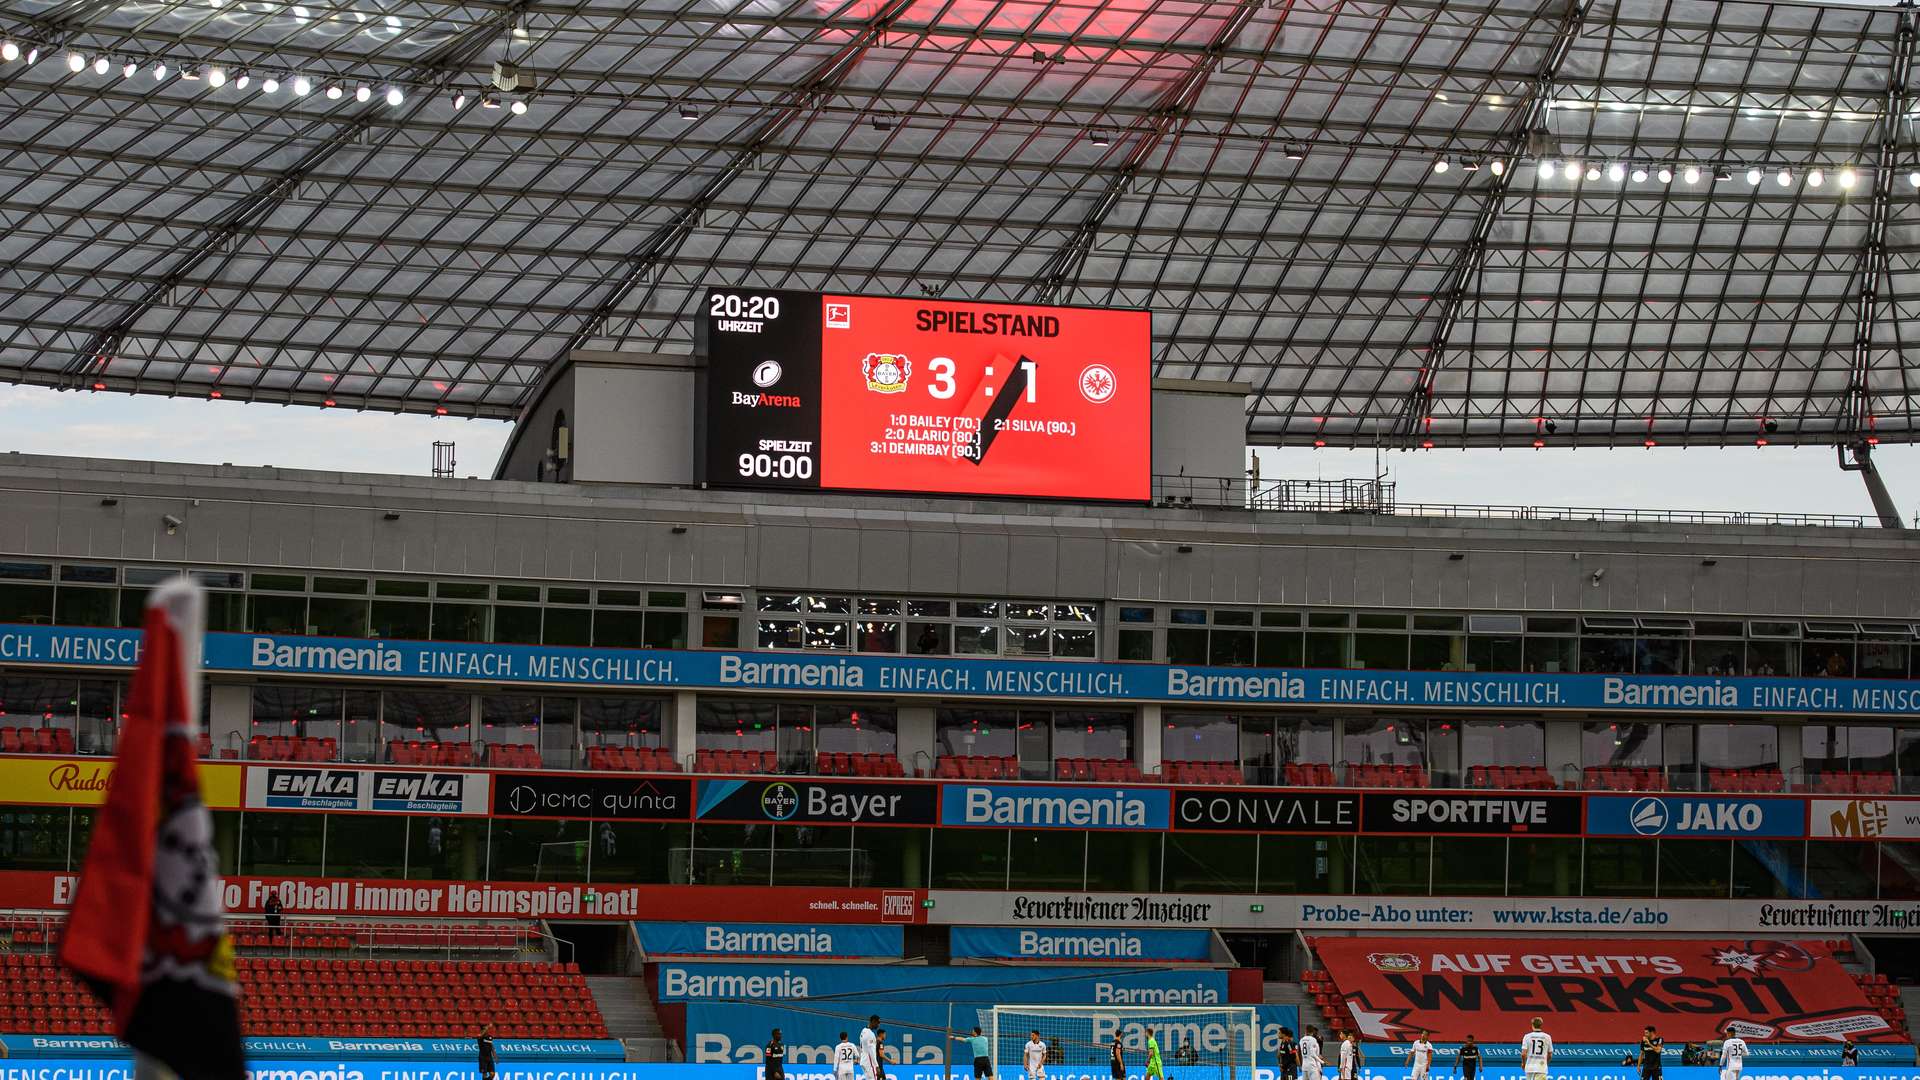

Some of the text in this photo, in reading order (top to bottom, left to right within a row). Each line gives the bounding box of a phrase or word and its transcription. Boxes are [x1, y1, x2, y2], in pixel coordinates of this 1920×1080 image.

[710, 294, 780, 320] 20:20
[718, 319, 764, 333] UHRZEIT
[915, 309, 1060, 338] SPIELSTAND
[927, 357, 956, 399] 3
[1020, 361, 1037, 403] 1
[732, 391, 801, 409] BayArena
[890, 414, 907, 426] 1:0
[909, 415, 951, 428] BAILEY
[994, 419, 1010, 431] 2:1
[1012, 419, 1045, 433] SILVA
[758, 439, 812, 453] SPIELZEIT
[885, 428, 905, 440] 2:0
[907, 429, 950, 442] ALARIO
[870, 442, 887, 453] 3:1
[889, 442, 950, 456] DEMIRBAY
[738, 453, 813, 479] 90:00
[252, 638, 680, 683] Barmenia EINFACH. MENSCHLICH.
[719, 655, 1130, 696] Barmenia EINFACH. MENSCHLICH.
[1167, 668, 1566, 705] Barmenia EINFACH. MENSCHLICH.
[1603, 677, 1738, 707] Barmenia
[1753, 686, 1844, 709] EINFACH.
[301, 798, 353, 808] Beschlagteile
[407, 801, 458, 811] Beschlagteile
[541, 793, 676, 814] ICMC quinta
[807, 786, 902, 822] Bayer
[966, 788, 1146, 826] Barmenia
[1181, 798, 1353, 825] CONVALE
[1392, 799, 1548, 824] SPORTFIVE
[1676, 803, 1763, 832] JAKO
[248, 880, 349, 910] Fußball
[354, 883, 442, 913] immer
[448, 884, 581, 917] Heimspiel
[586, 887, 639, 916] hat!
[809, 900, 879, 911] schnell. schneller.
[884, 895, 913, 916] EXPRESS
[1131, 897, 1212, 923] Anzeiger
[1302, 905, 1669, 925] Probe-Abo unter: www.ksta.de/abo
[705, 926, 832, 952] Barmenia
[1020, 931, 1142, 956] Barmenia
[1431, 953, 1683, 975] AUF GEHT'S
[666, 968, 808, 998] Barmenia
[1095, 982, 1218, 1004] Barmenia
[1382, 973, 1805, 1014] WERKS11
[33, 1038, 131, 1049] Barmenia
[329, 1040, 596, 1054] Barmenia EINFAC MENSCHLICH.
[841, 1047, 853, 1061] 32
[1302, 1042, 1308, 1055] 8
[1531, 1039, 1544, 1056] 13
[1732, 1043, 1743, 1057] 35
